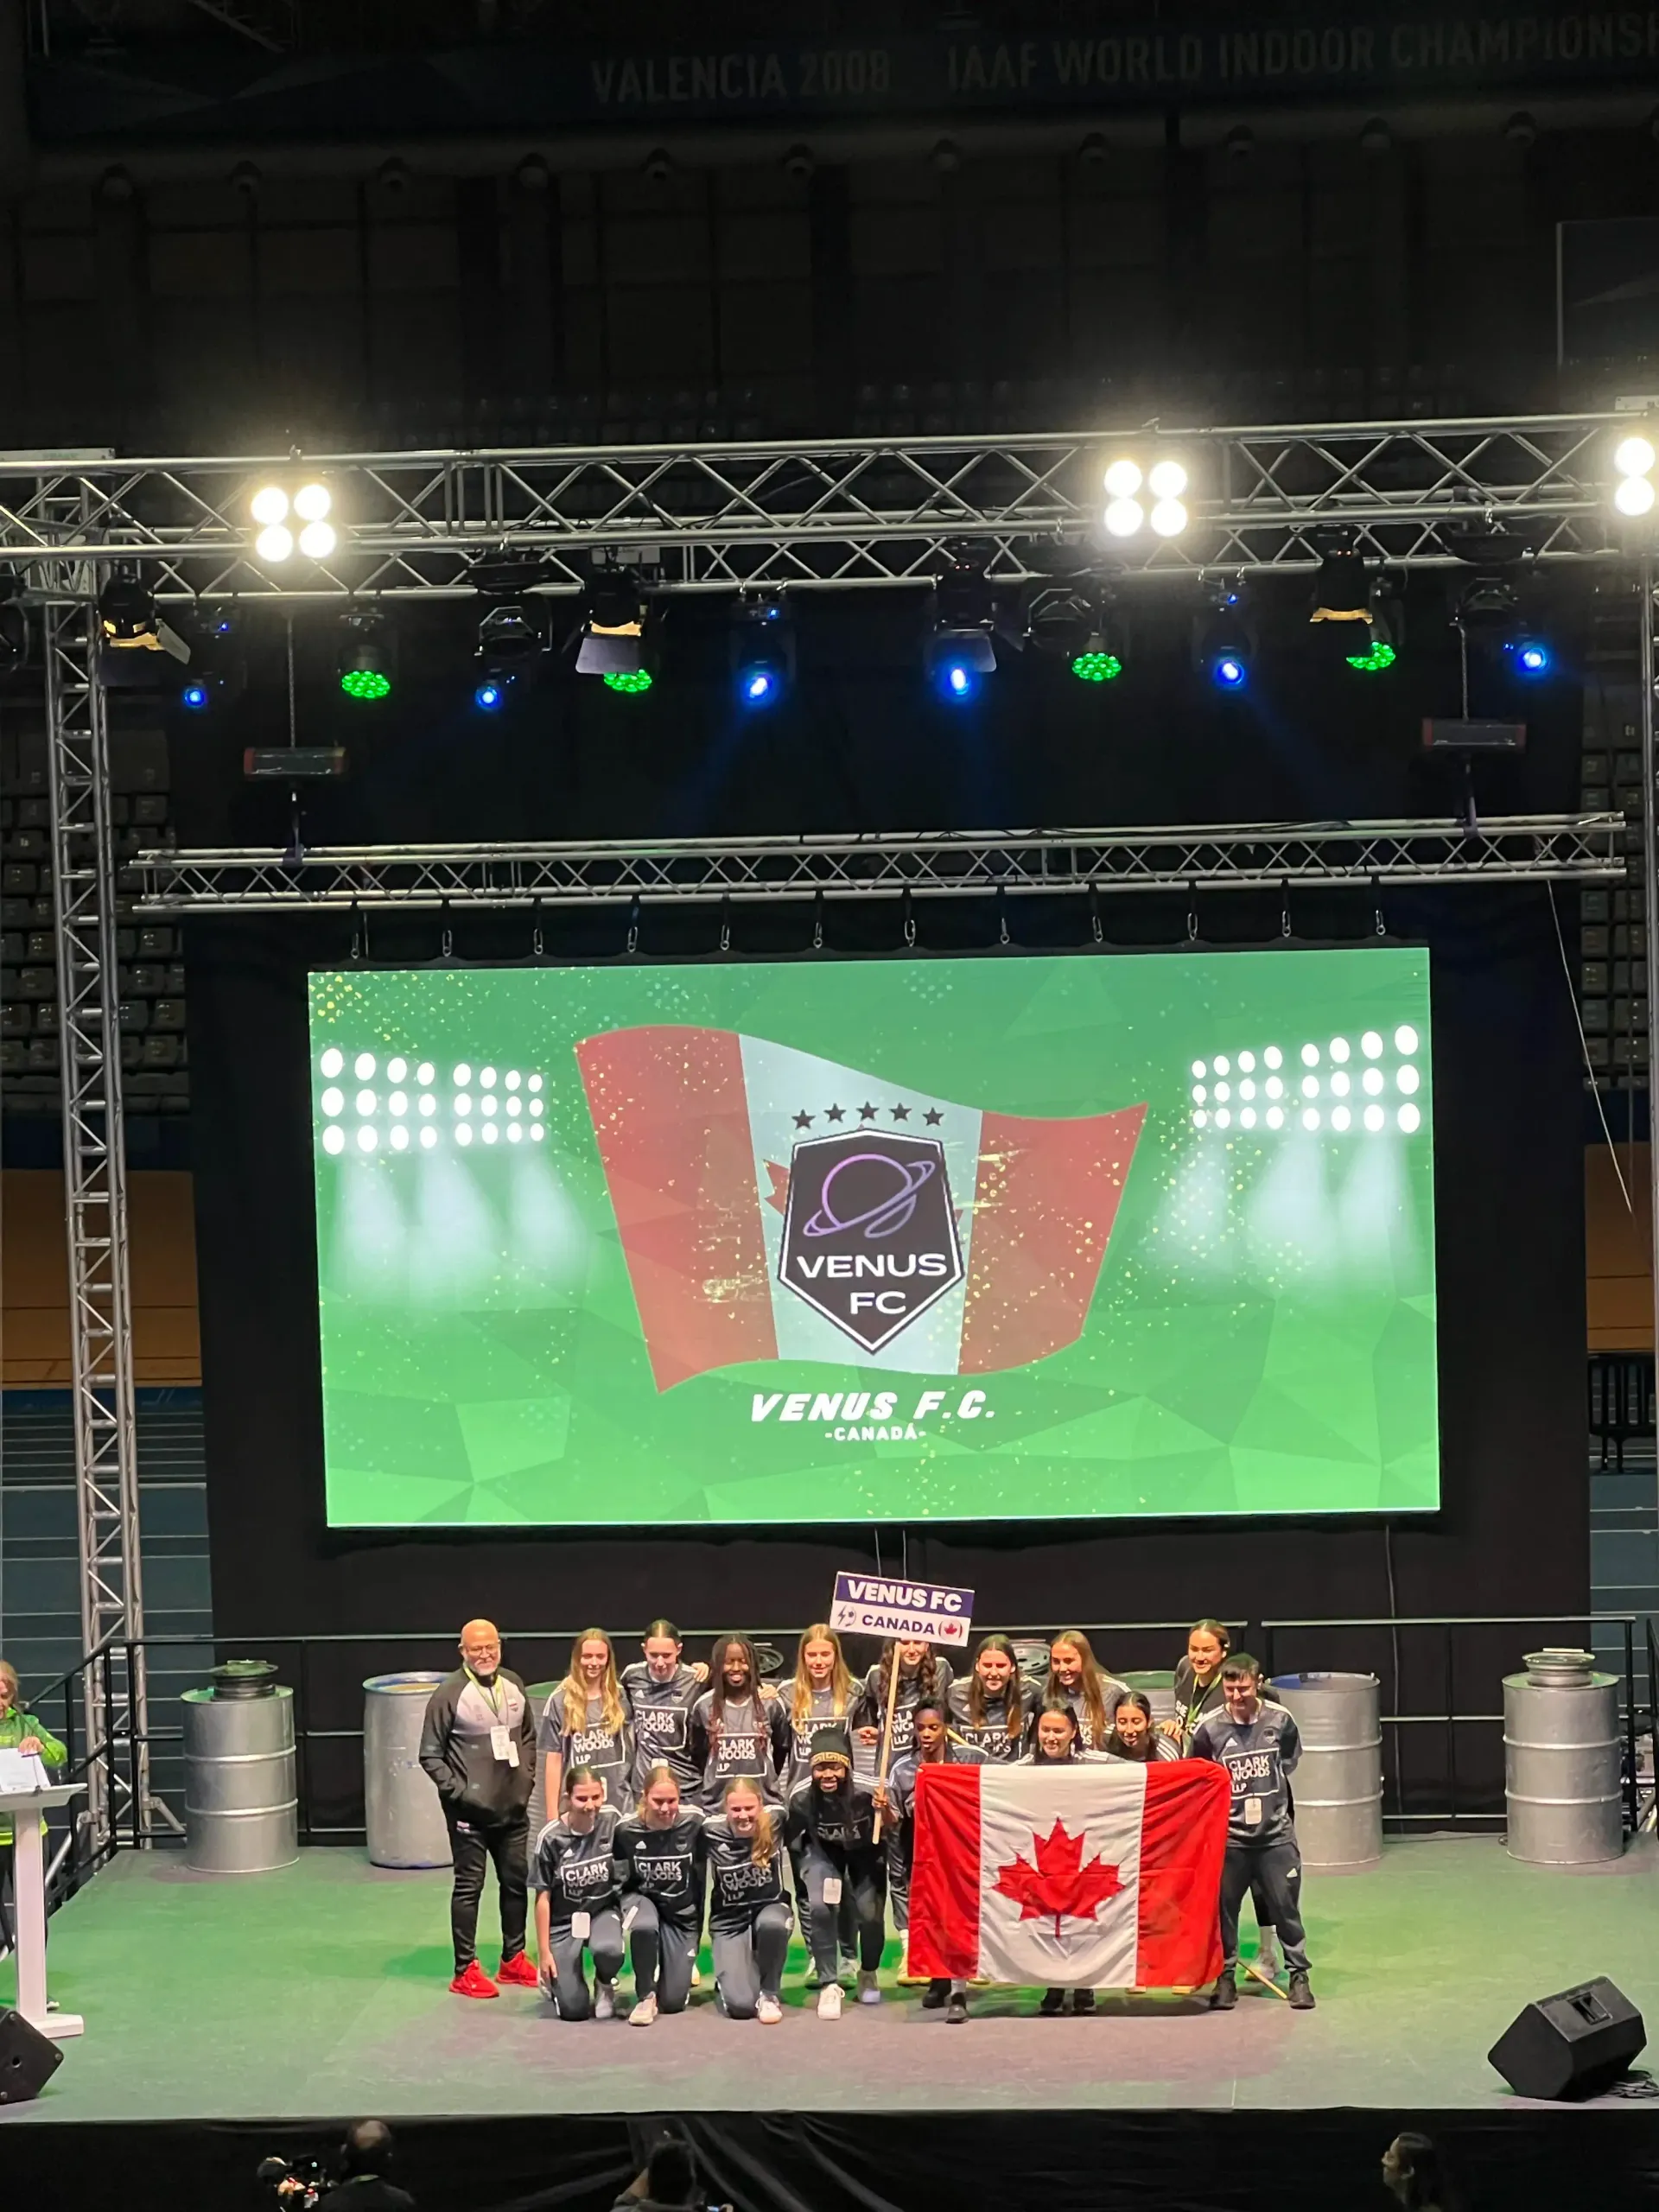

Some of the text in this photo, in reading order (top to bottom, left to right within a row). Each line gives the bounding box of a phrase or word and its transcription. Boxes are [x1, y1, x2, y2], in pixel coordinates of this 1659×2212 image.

[948, 41, 1038, 89] IAAF
[1052, 33, 1203, 84] WORLD
[1218, 26, 1375, 78] INDOOR
[590, 49, 891, 103] VALENCIA 2008
[797, 1253, 947, 1278] VENUS
[849, 1291, 906, 1314] FC
[751, 1389, 995, 1421] VENUS F.C.
[847, 1580, 963, 1612] VENUS FC
[861, 1614, 935, 1635] CANADA
[574, 1738, 614, 1752] WOODS
[575, 1754, 591, 1764] LLP
[1229, 1755, 1269, 1771] CLARK
[1231, 1767, 1270, 1782] WOODS
[1231, 1783, 1247, 1793] LLP
[565, 1861, 608, 1881] CLARK
[639, 1861, 681, 1873] CLARK
[723, 1866, 772, 1884] CLARK
[567, 1872, 609, 1887] WOODS
[725, 1876, 772, 1891] WOODS
